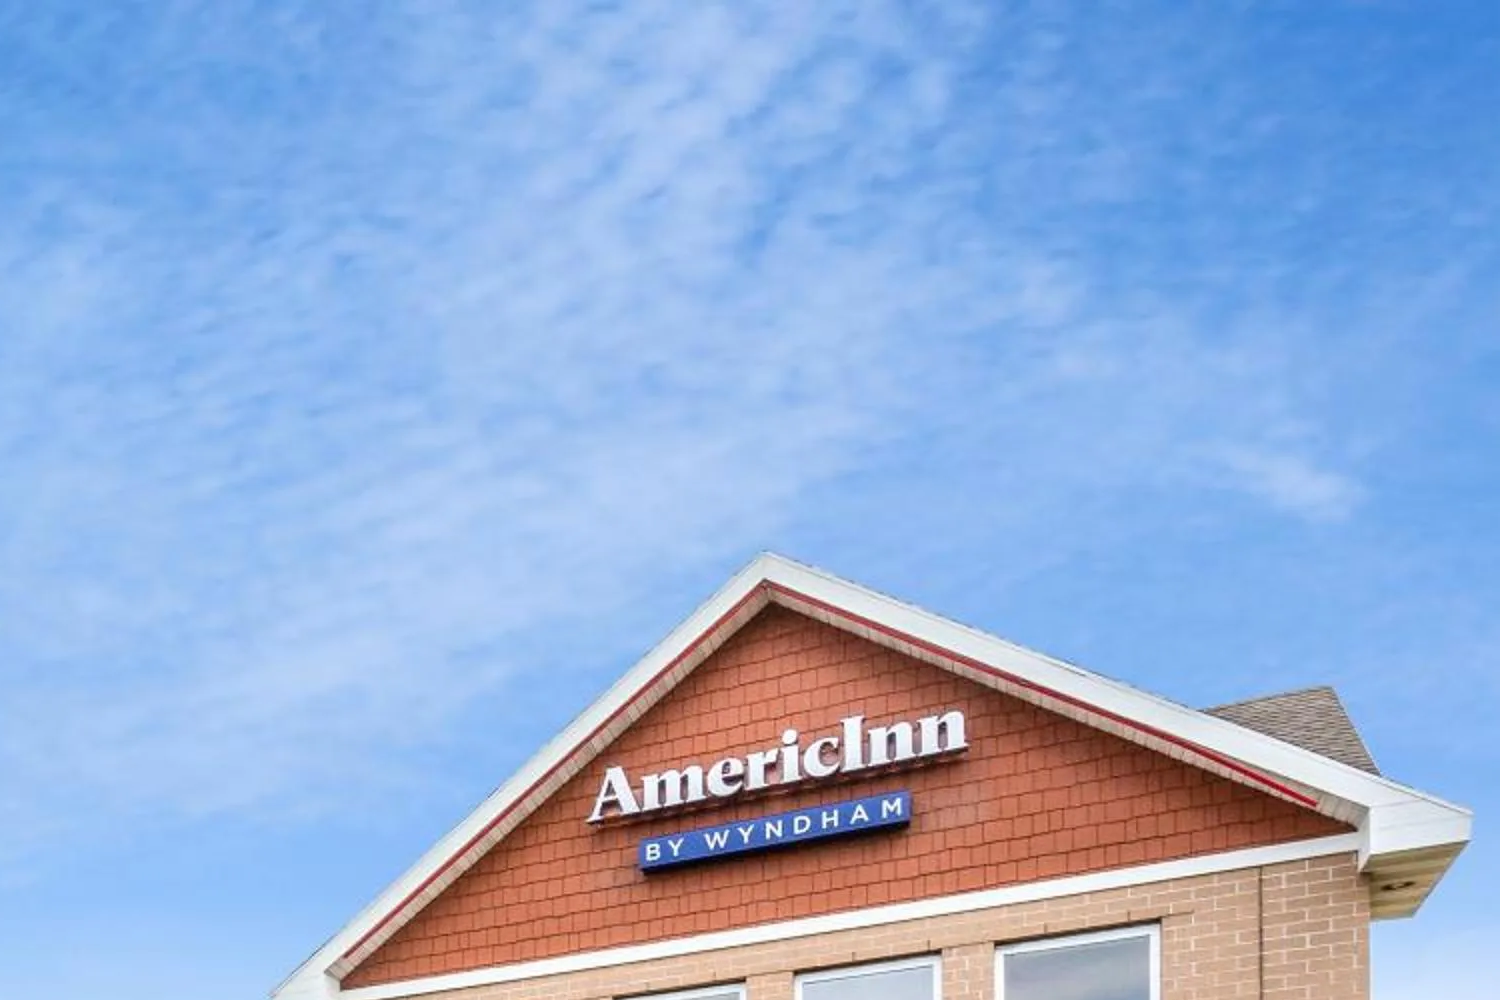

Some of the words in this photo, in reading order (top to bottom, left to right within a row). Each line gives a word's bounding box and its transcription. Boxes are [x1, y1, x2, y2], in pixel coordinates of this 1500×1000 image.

[586, 709, 970, 824] AmericInn
[645, 837, 685, 862] BY
[704, 796, 903, 850] WYNDHAM
